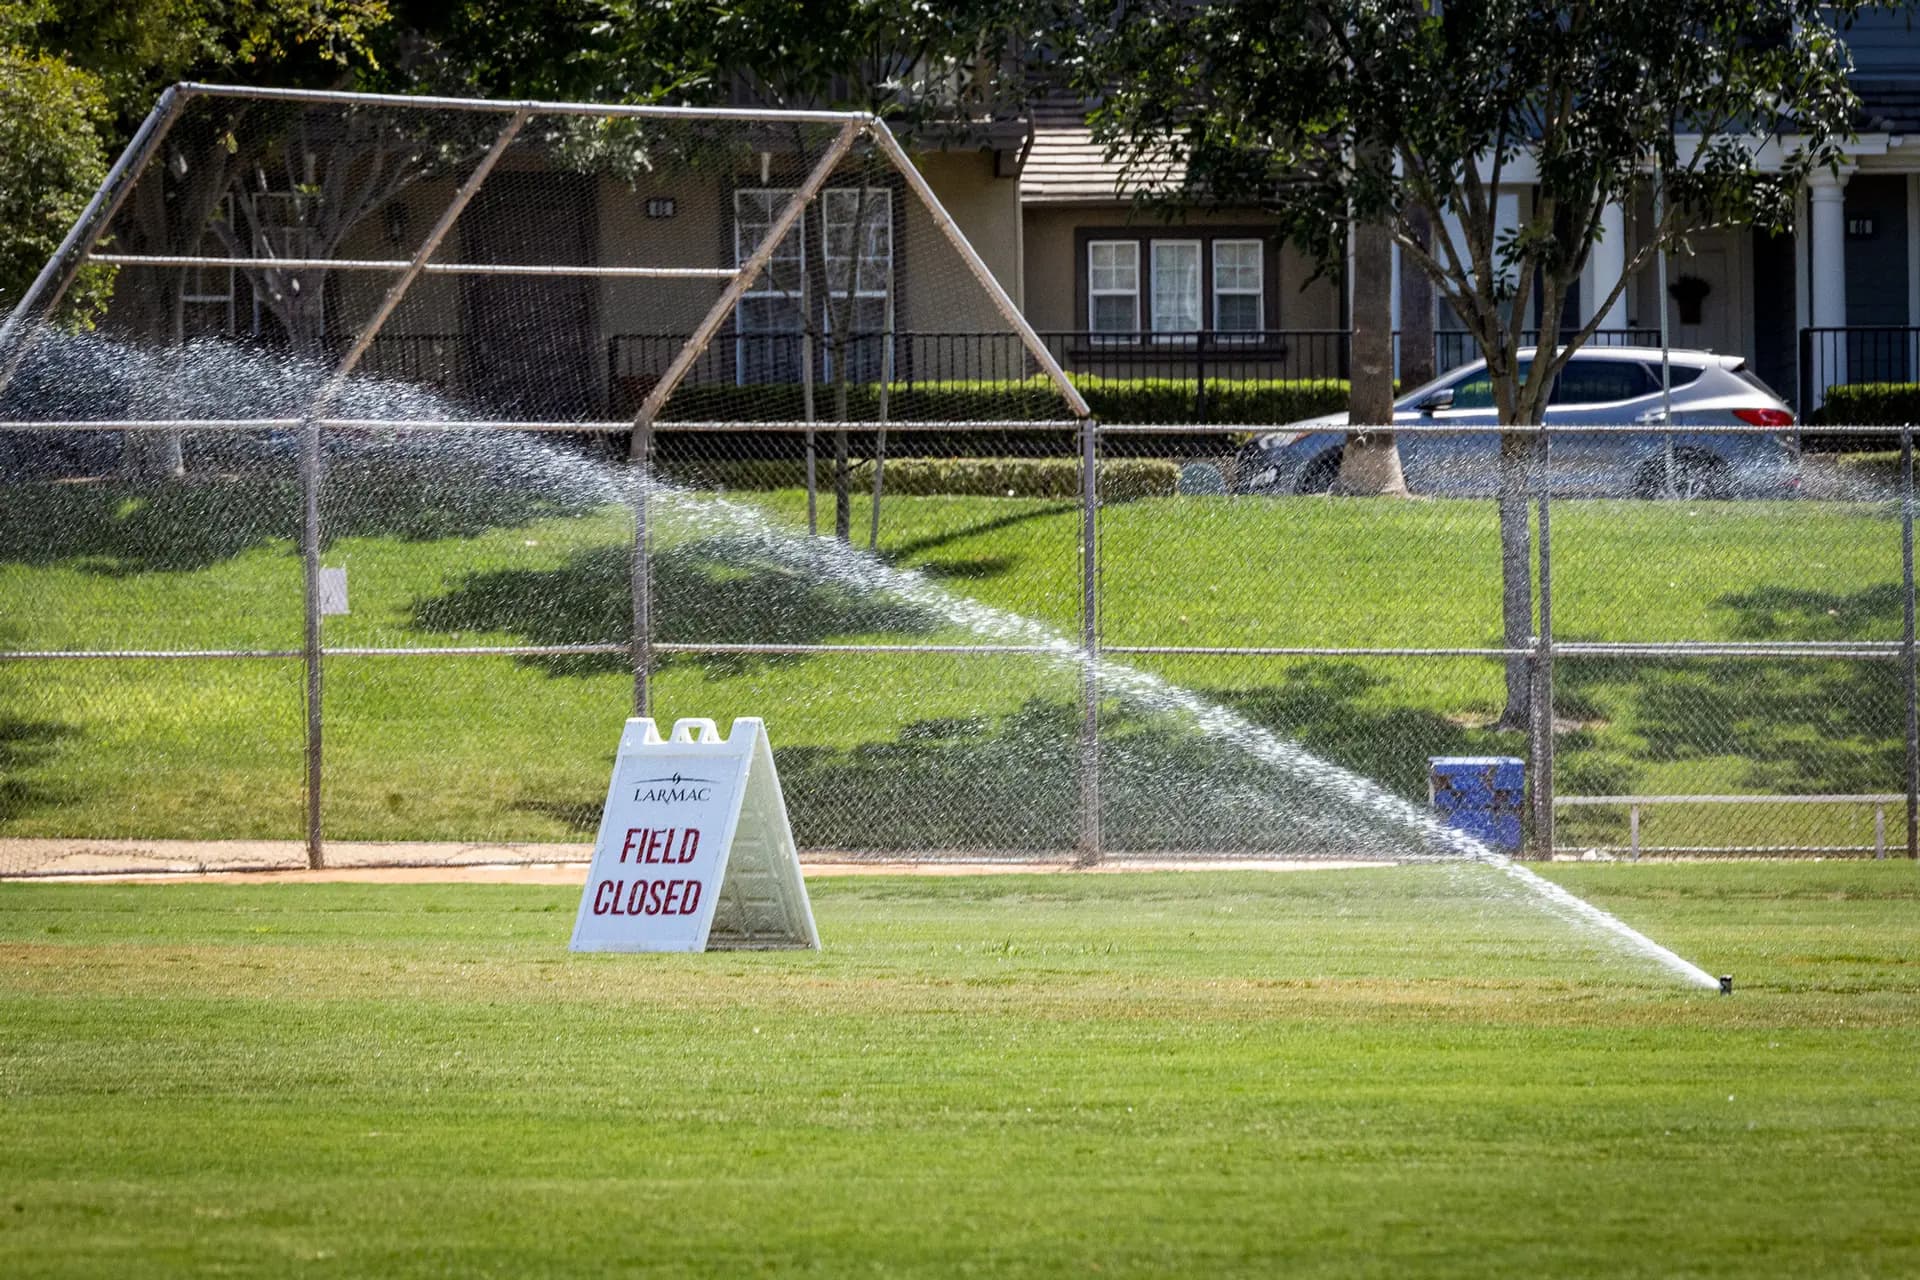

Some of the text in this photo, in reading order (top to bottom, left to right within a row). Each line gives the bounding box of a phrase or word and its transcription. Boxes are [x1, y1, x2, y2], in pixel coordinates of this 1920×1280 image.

[633, 788, 711, 804] LARMAC
[620, 828, 700, 864] FIELD
[593, 879, 702, 916] CLOSED
